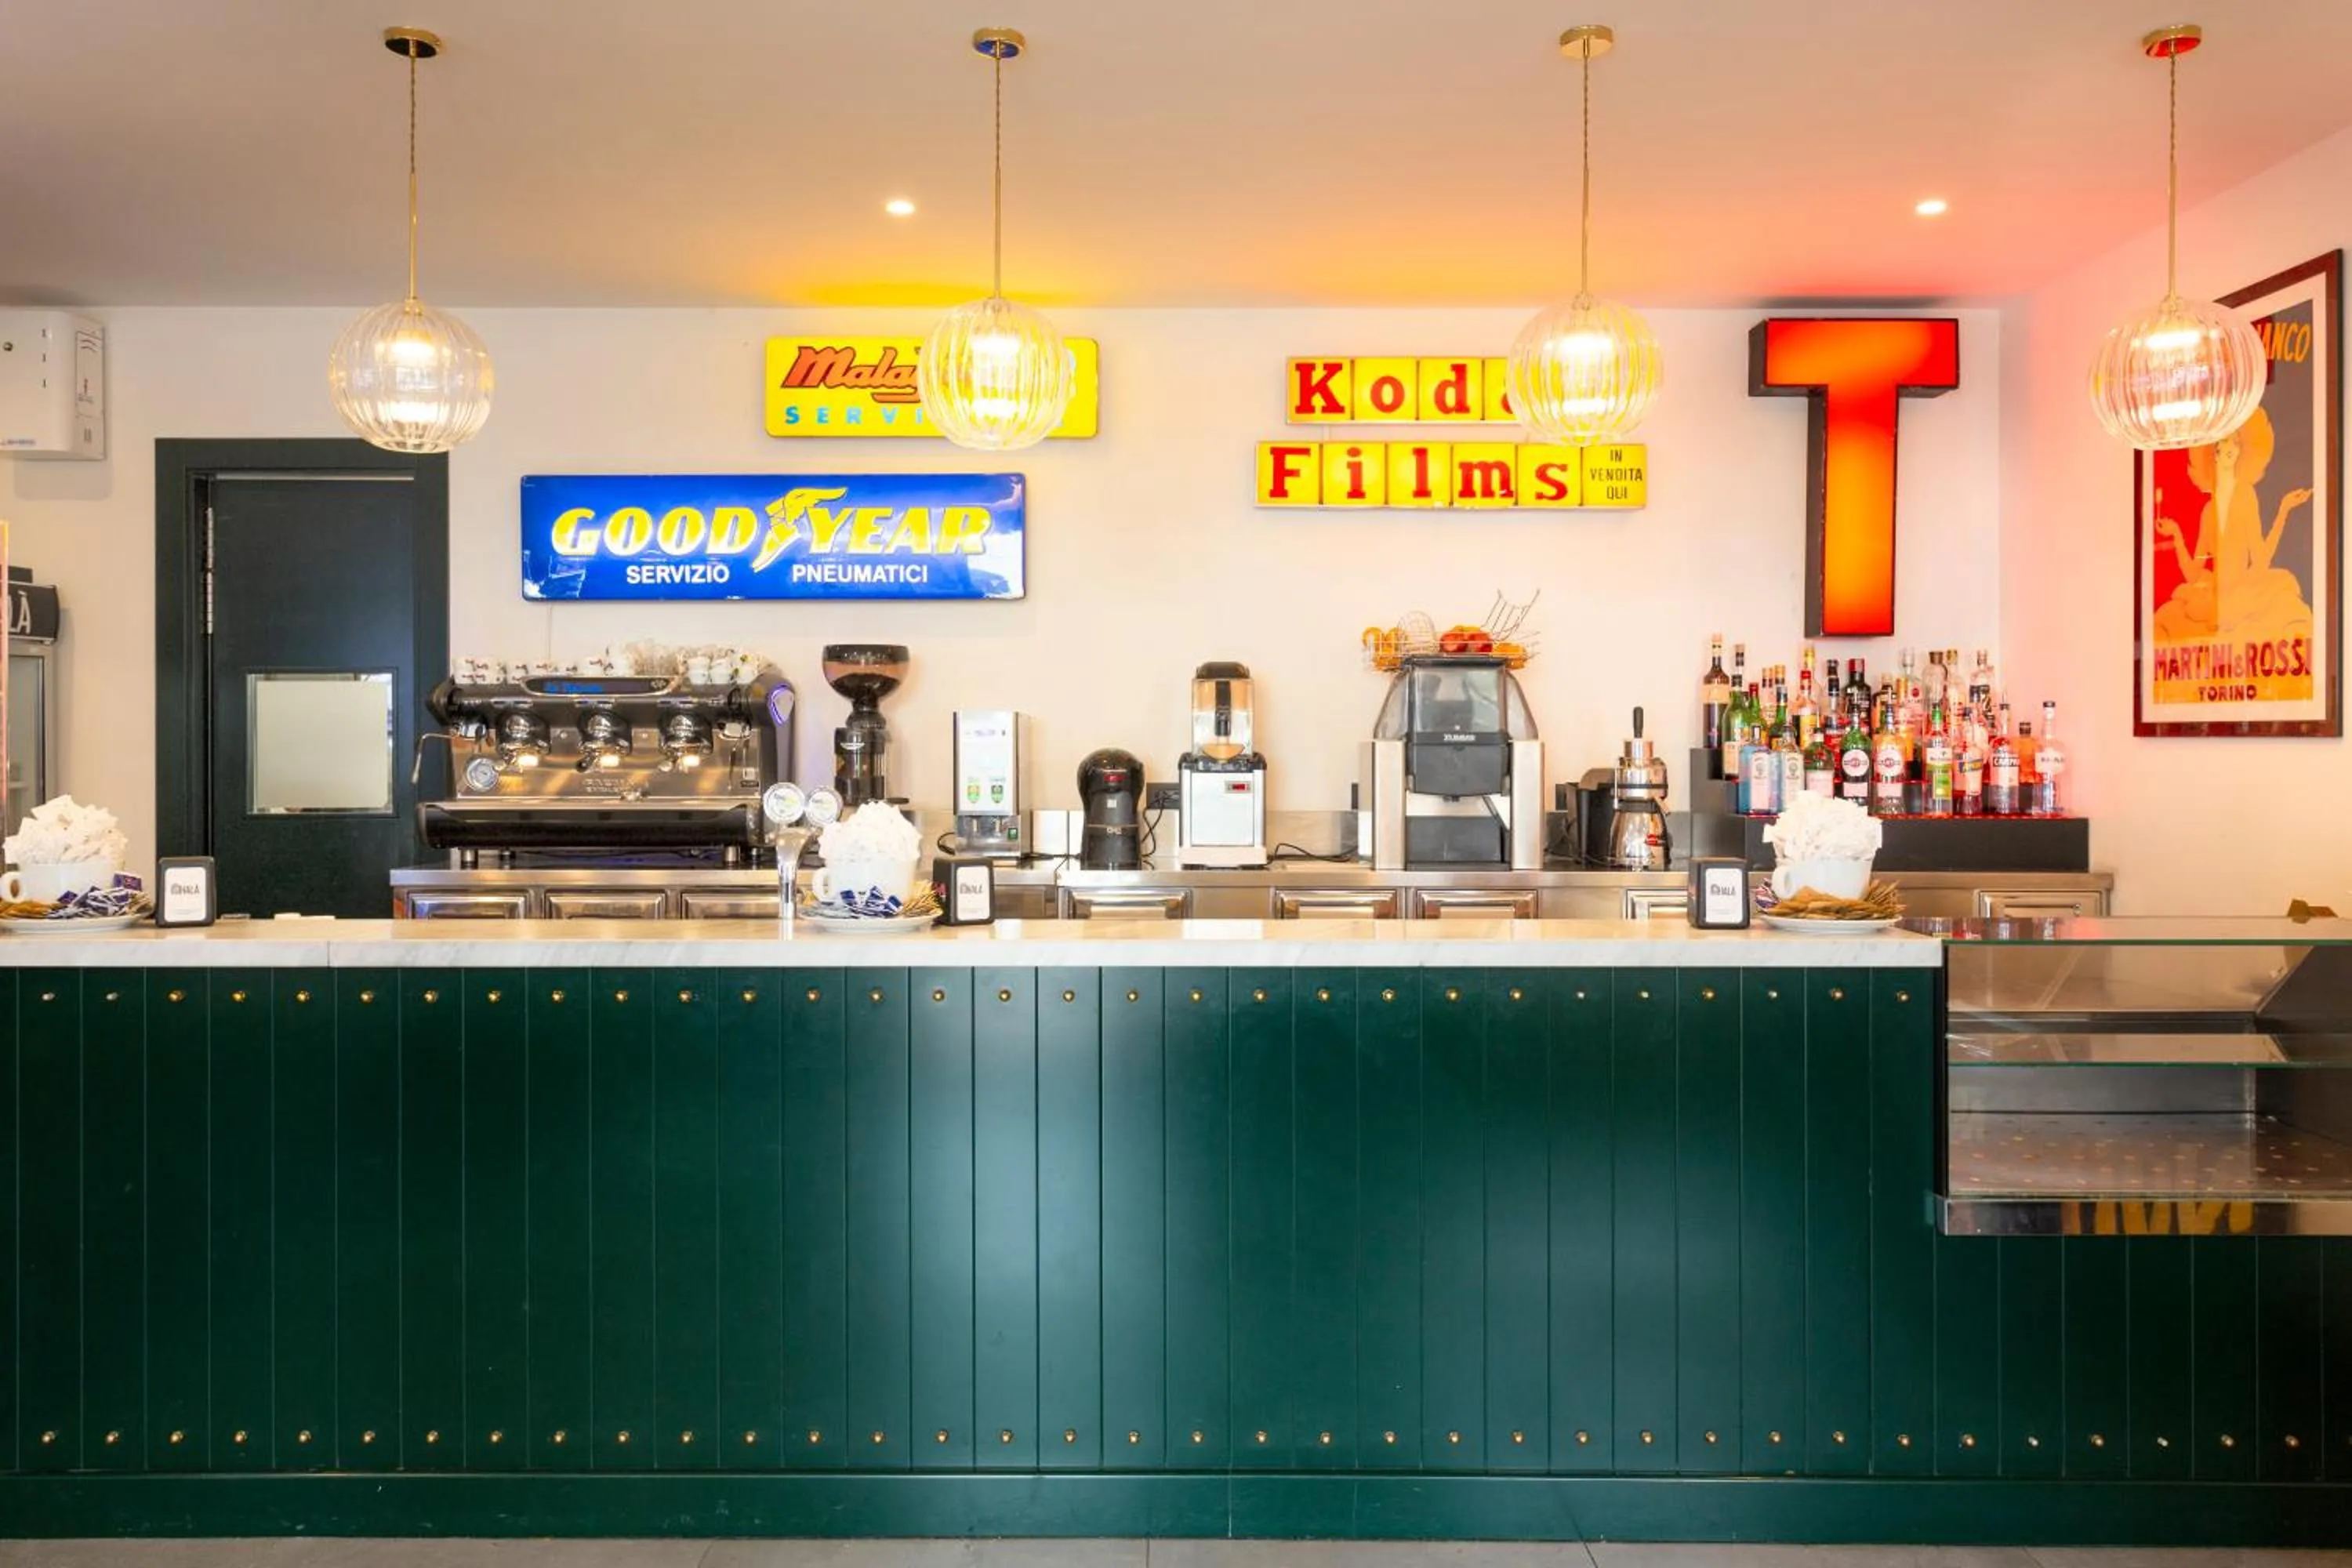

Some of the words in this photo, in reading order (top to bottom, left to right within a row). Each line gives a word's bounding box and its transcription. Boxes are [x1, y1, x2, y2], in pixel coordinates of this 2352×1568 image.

[2258, 322, 2310, 362] ANCO
[781, 346, 922, 403] Mala
[1295, 363, 1512, 415] Kod
[785, 406, 922, 425] SERVI
[1610, 449, 1622, 462] IN
[1269, 447, 1569, 501] Films
[1590, 467, 1642, 481] VENDITA
[1764, 318, 1959, 637] T
[1606, 485, 1627, 499] QUI
[626, 564, 730, 585] SERVIZIO
[792, 564, 928, 584] PNEUMATICI
[2198, 684, 2257, 702] TORINO
